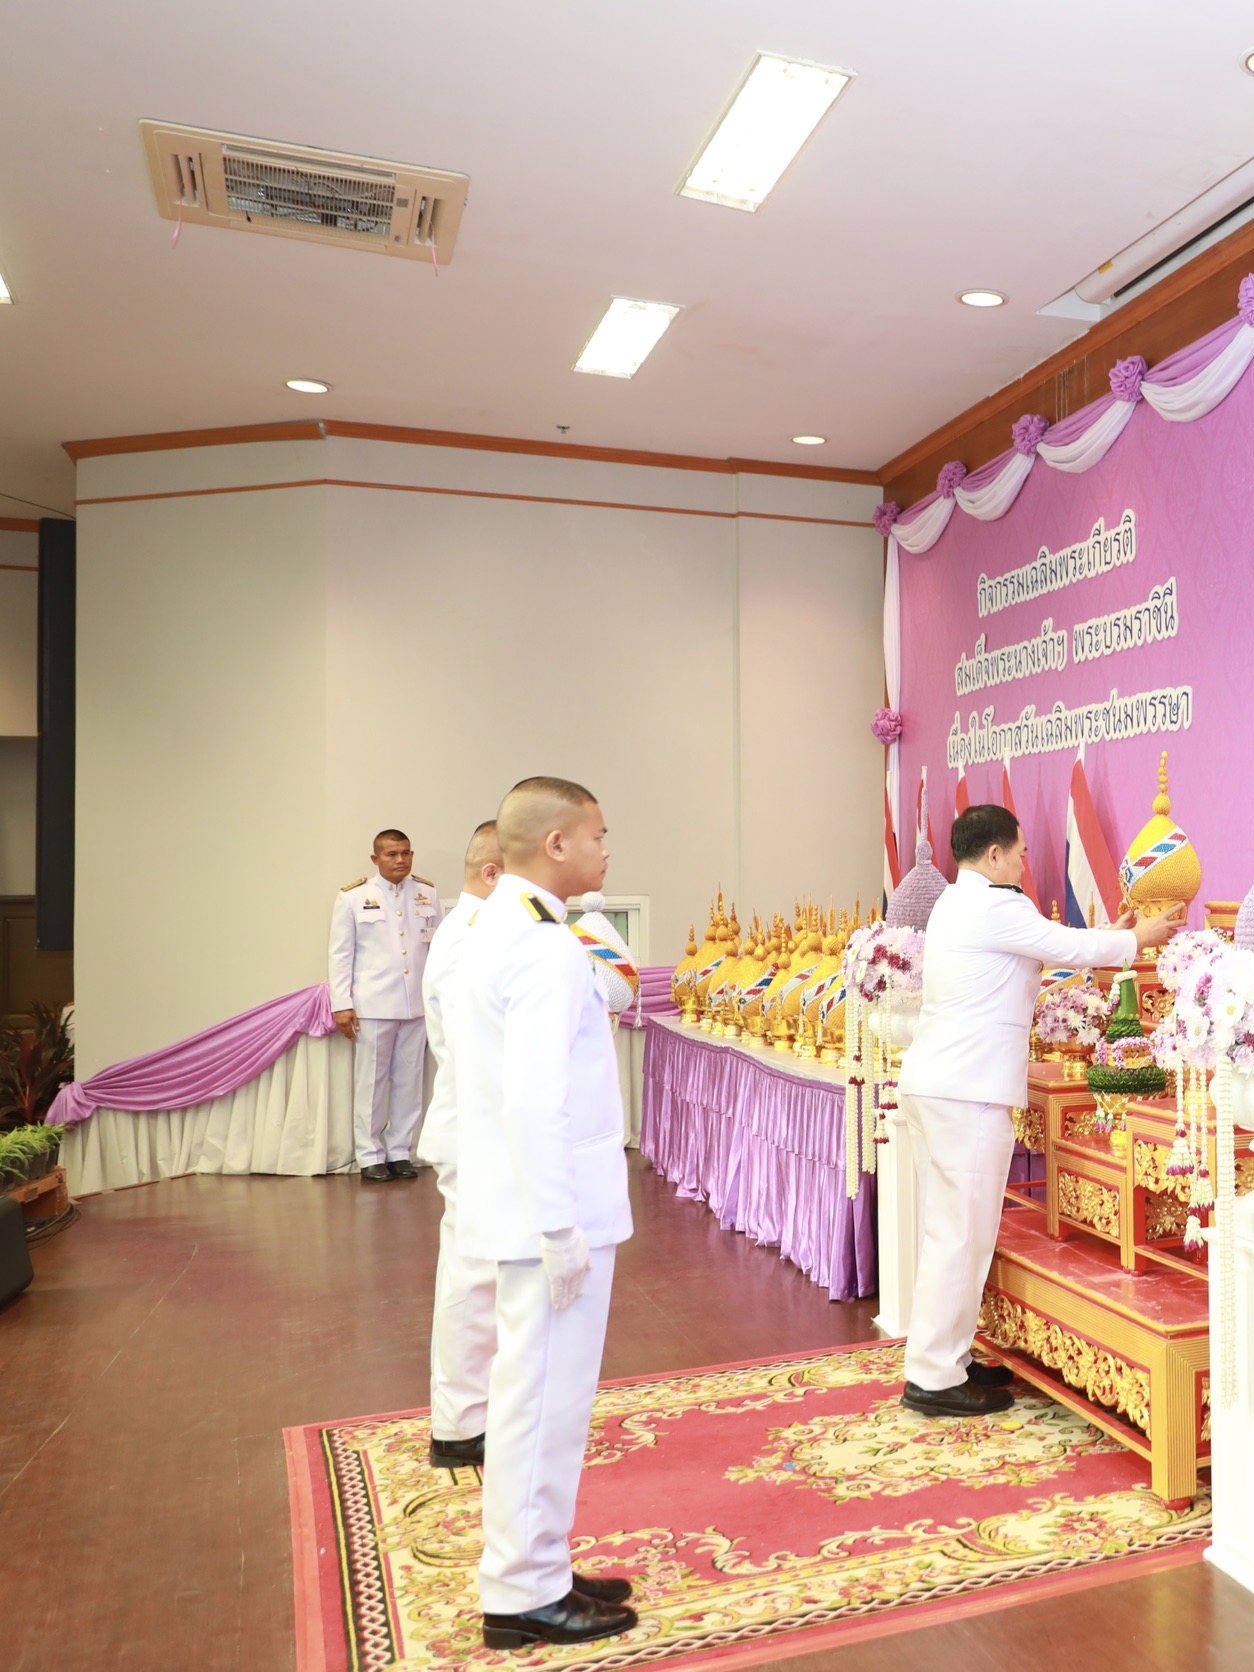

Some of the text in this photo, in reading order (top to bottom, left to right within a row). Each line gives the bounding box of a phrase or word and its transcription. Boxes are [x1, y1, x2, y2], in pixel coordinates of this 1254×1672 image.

[977, 514, 1134, 614] กิจกรรมเฉลิมพระเกียรติ
[955, 582, 1175, 693] สมเด็จพระนางเจ้าฯ พระบรมราชินี
[948, 691, 1190, 763] เนื่องในโอกาสวันเฉลิมพระชนมพรรษา
